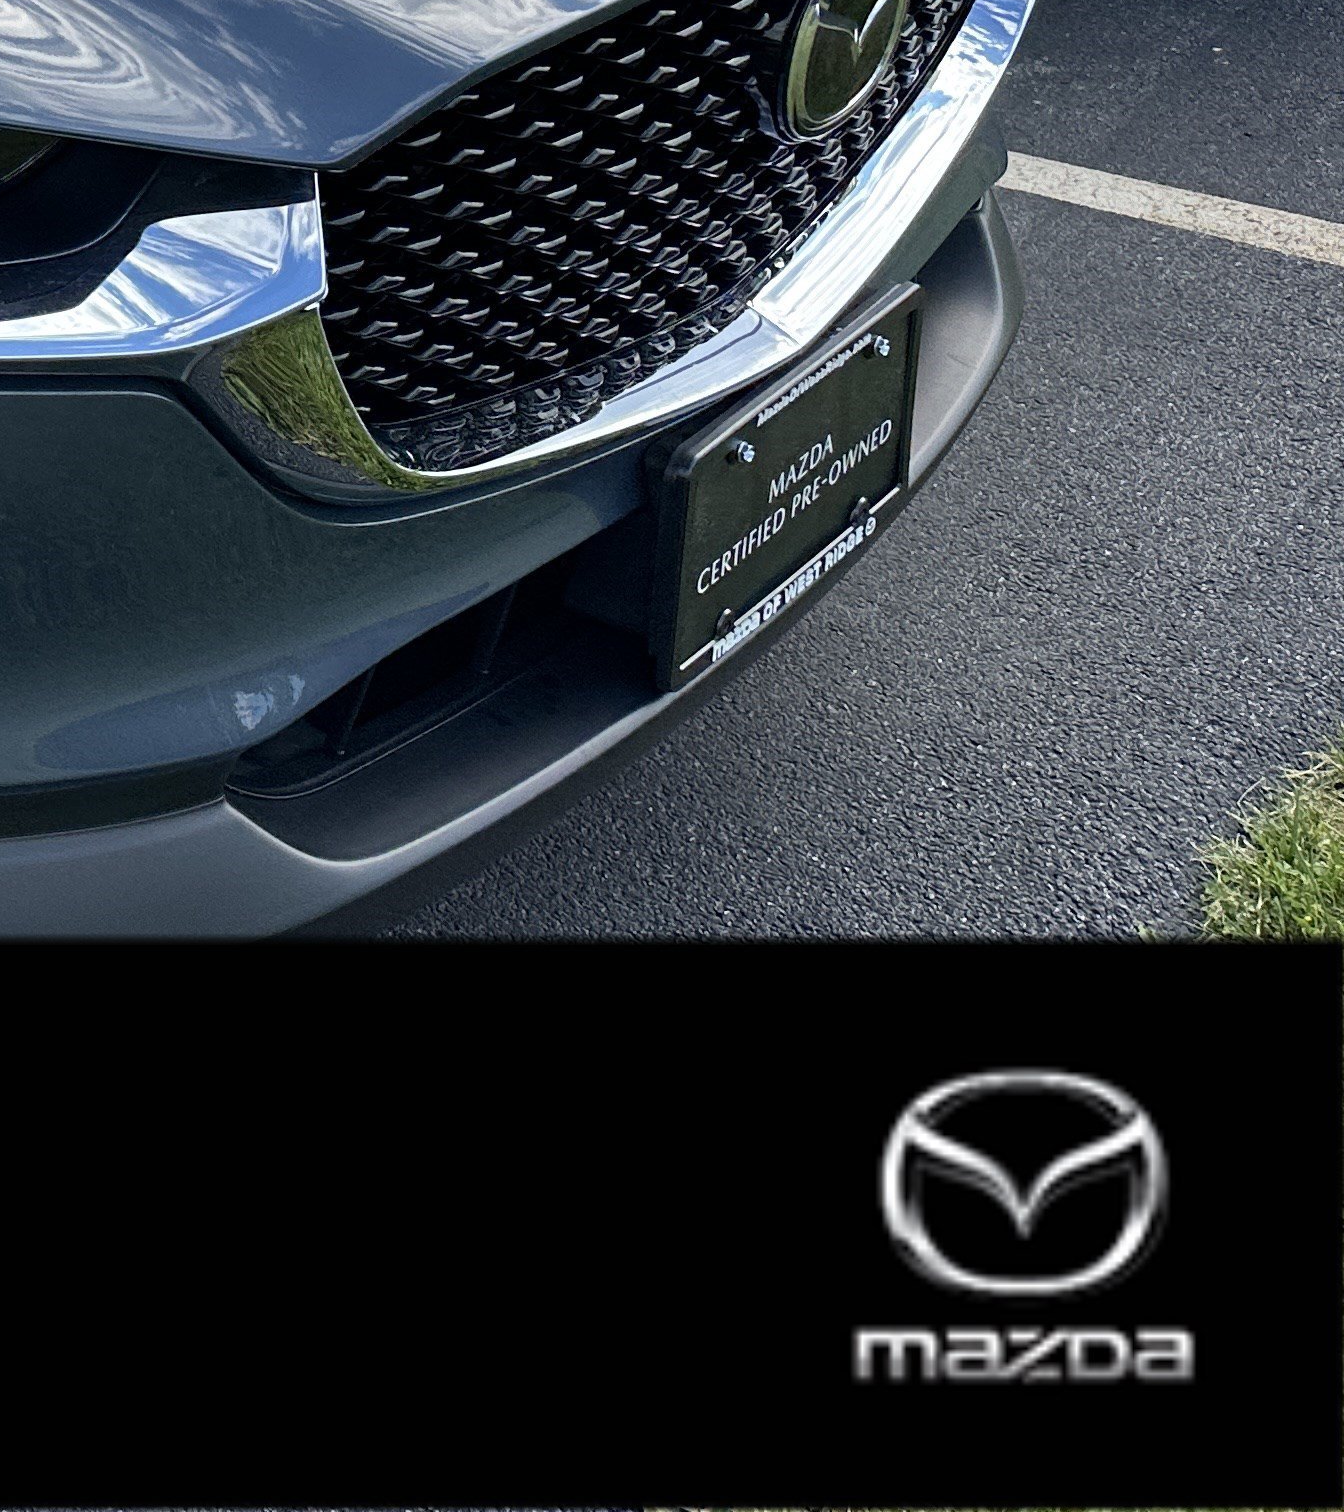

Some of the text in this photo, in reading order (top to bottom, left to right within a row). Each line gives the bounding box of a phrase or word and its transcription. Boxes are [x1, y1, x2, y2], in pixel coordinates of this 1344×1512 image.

[696, 419, 893, 595] CERTIFIED PRE-OWNED
[768, 433, 834, 504] MAZDA
[762, 593, 782, 621] OF
[784, 560, 823, 603] WEST
[823, 525, 864, 572] RIDGE
